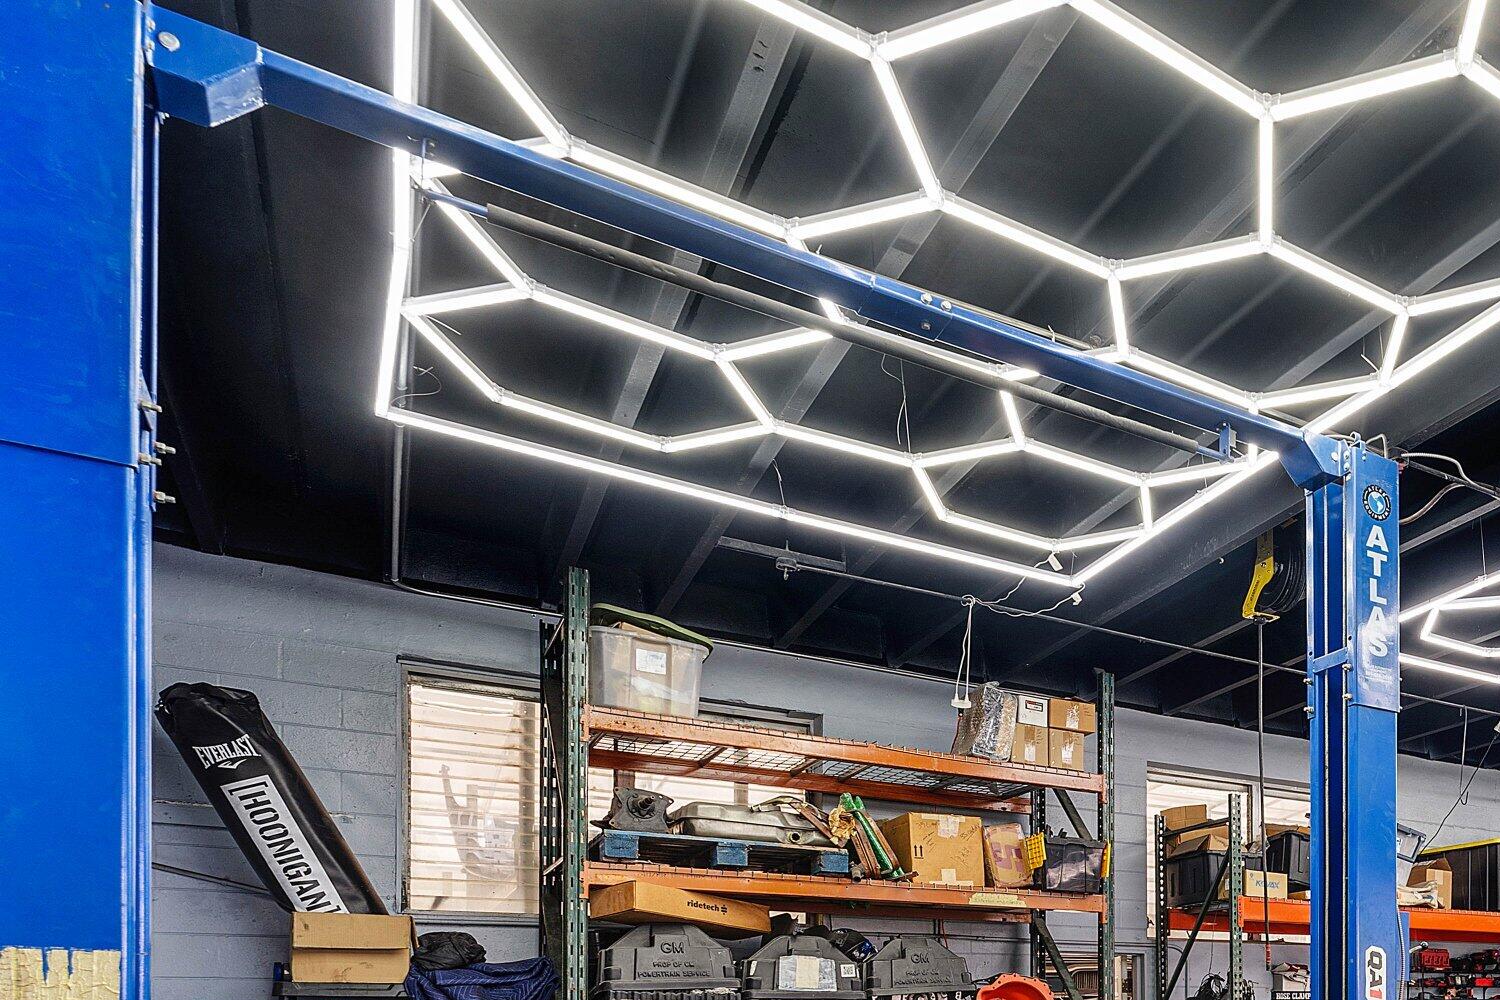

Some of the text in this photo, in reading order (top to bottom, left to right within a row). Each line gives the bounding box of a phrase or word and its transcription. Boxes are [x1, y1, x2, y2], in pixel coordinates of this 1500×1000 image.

[1365, 524, 1389, 658] ATLAS
[192, 734, 261, 770] EVERLAST
[687, 900, 720, 912] ridetech
[660, 941, 684, 954] GM
[911, 952, 929, 964] GM
[1367, 950, 1383, 1000] QA1
[1276, 992, 1291, 1000] HOSE
